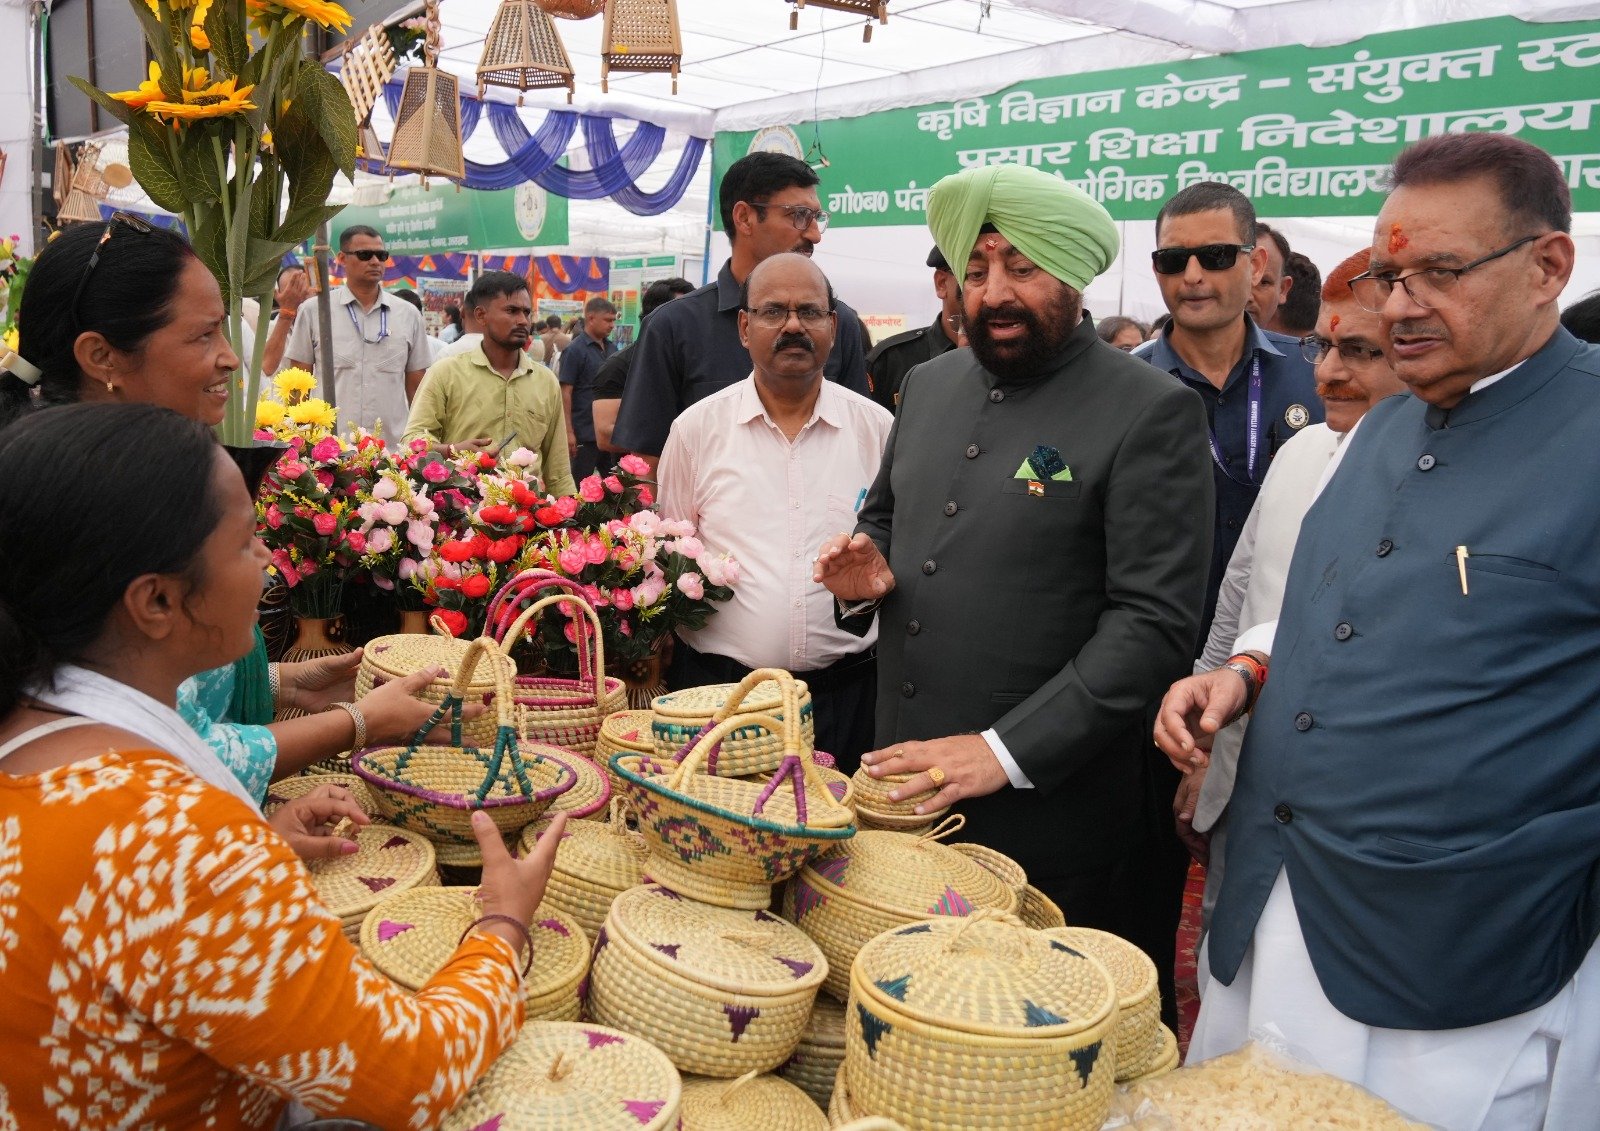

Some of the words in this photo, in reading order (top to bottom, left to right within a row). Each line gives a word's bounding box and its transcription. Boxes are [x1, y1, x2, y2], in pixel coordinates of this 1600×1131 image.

[917, 100, 990, 140] कृषि
[999, 90, 1126, 126] विज्ञान
[1135, 73, 1247, 110] केन्द्र
[1308, 45, 1502, 103] संयुक्त
[956, 141, 1077, 169] प्रसार
[1085, 128, 1222, 161] शिक्षा
[1238, 98, 1600, 151] निदेशालय
